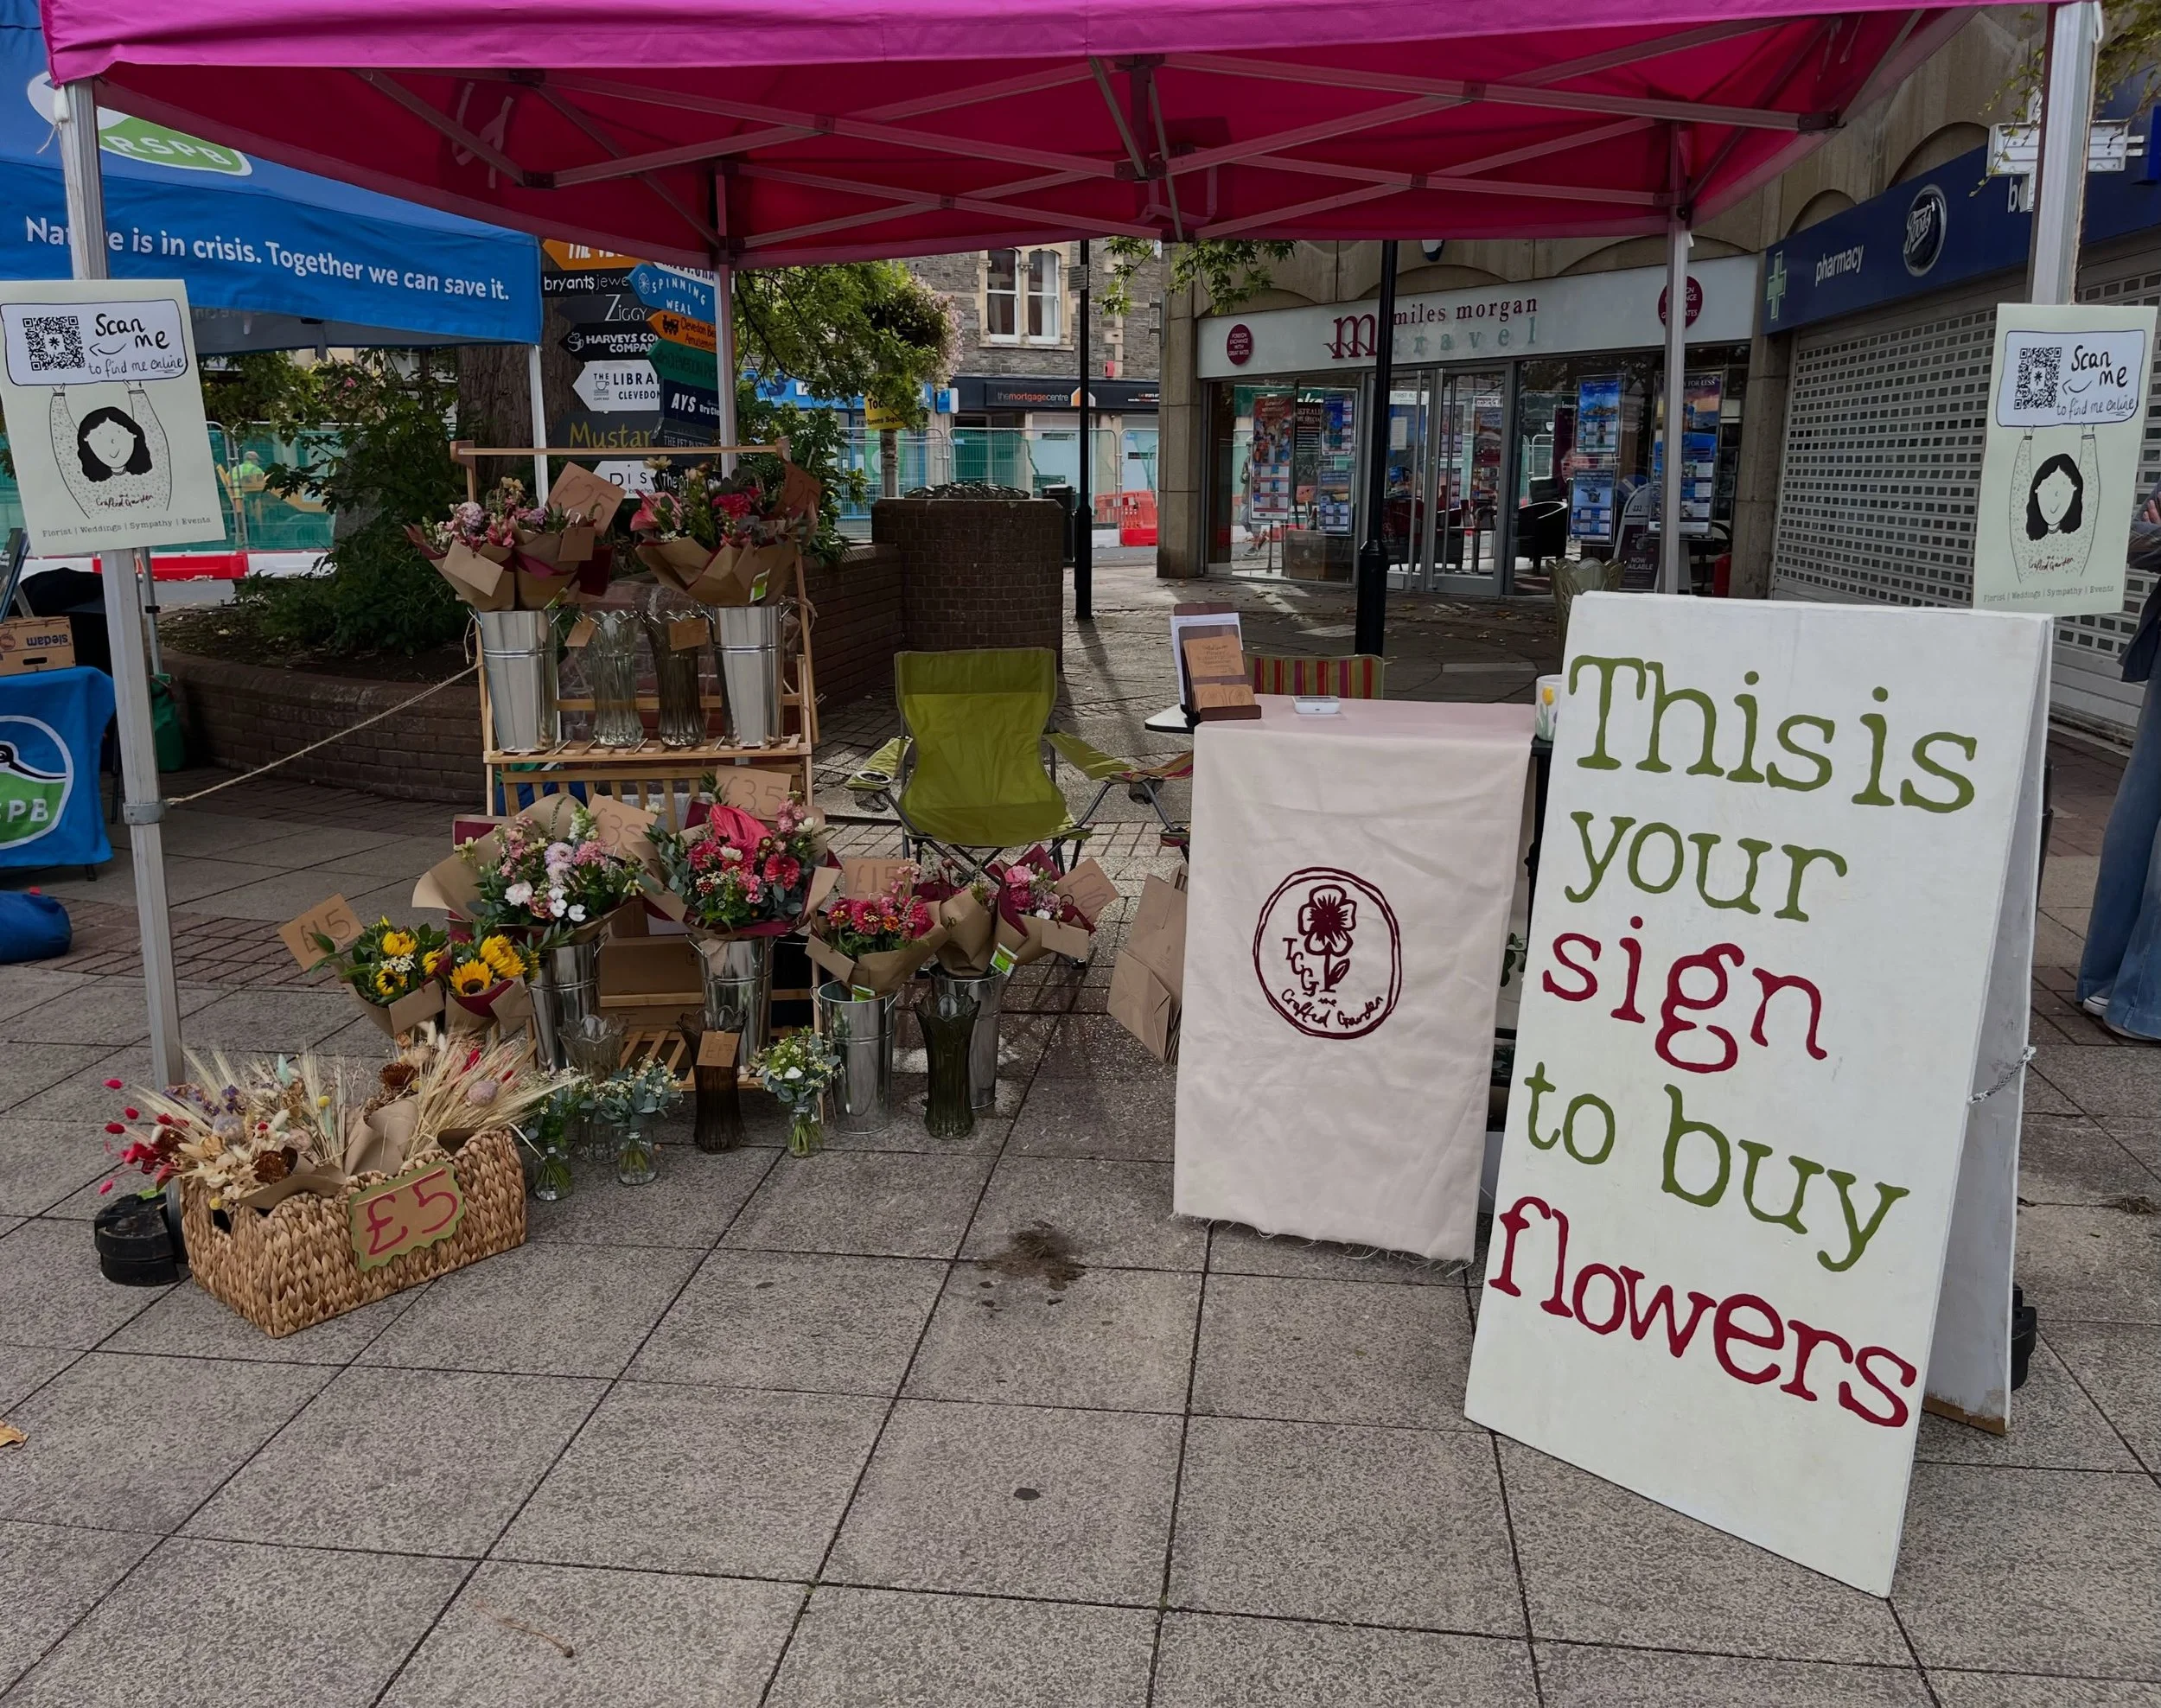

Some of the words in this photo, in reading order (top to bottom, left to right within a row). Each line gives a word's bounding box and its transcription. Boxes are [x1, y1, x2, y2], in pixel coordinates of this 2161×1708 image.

[103, 134, 233, 166] RSPB
[1903, 196, 1935, 255] Boots
[26, 216, 124, 252] Nate
[132, 228, 153, 253] is
[161, 230, 186, 256] in
[194, 236, 262, 264] crisis.
[265, 241, 363, 280] Together
[368, 265, 398, 286] we
[404, 271, 439, 292] can
[444, 277, 486, 297] save
[490, 278, 509, 300] it.
[1815, 245, 1865, 288] pharmacy
[544, 276, 595, 292] bryants
[652, 277, 706, 306] SPINNING
[666, 299, 692, 315] WEAL
[1393, 303, 1447, 326] miles
[1457, 297, 1538, 322] morgan
[95, 313, 146, 337] Scan
[135, 331, 170, 349] me
[586, 334, 638, 345] HARVEYS
[88, 364, 101, 374] to
[105, 359, 127, 379] find
[131, 361, 148, 372] me
[150, 355, 184, 370] online
[2071, 344, 2113, 372] Scan
[613, 373, 660, 386] LIBRA
[2100, 366, 2128, 388] me
[671, 392, 697, 413] AYS
[699, 404, 711, 415] Dry
[2056, 403, 2067, 416] to
[2069, 397, 2088, 419] find
[2090, 401, 2103, 413] me
[664, 436, 676, 447] THE
[662, 472, 678, 488] The
[42, 528, 72, 538] Florist
[80, 524, 122, 534] Weddings
[130, 519, 172, 530] Sympathy
[182, 517, 211, 526] Events
[1983, 594, 2006, 602] Florist
[2011, 590, 2041, 600] Weddings
[2047, 587, 2082, 597] Sympathy
[2089, 584, 2114, 594] Events
[1569, 654, 1835, 792] This
[1852, 685, 1978, 813] is
[723, 774, 784, 817] £35
[1564, 811, 1848, 922] your
[1317, 997, 1337, 1007] the
[1542, 915, 1827, 1073] sign
[1281, 988, 1331, 1028] Crafted
[1337, 996, 1384, 1029] Garden
[1524, 1061, 1616, 1165] to
[1661, 1083, 1911, 1272] buy
[366, 1165, 458, 1257] £5
[1488, 1196, 1917, 1428] flowers
